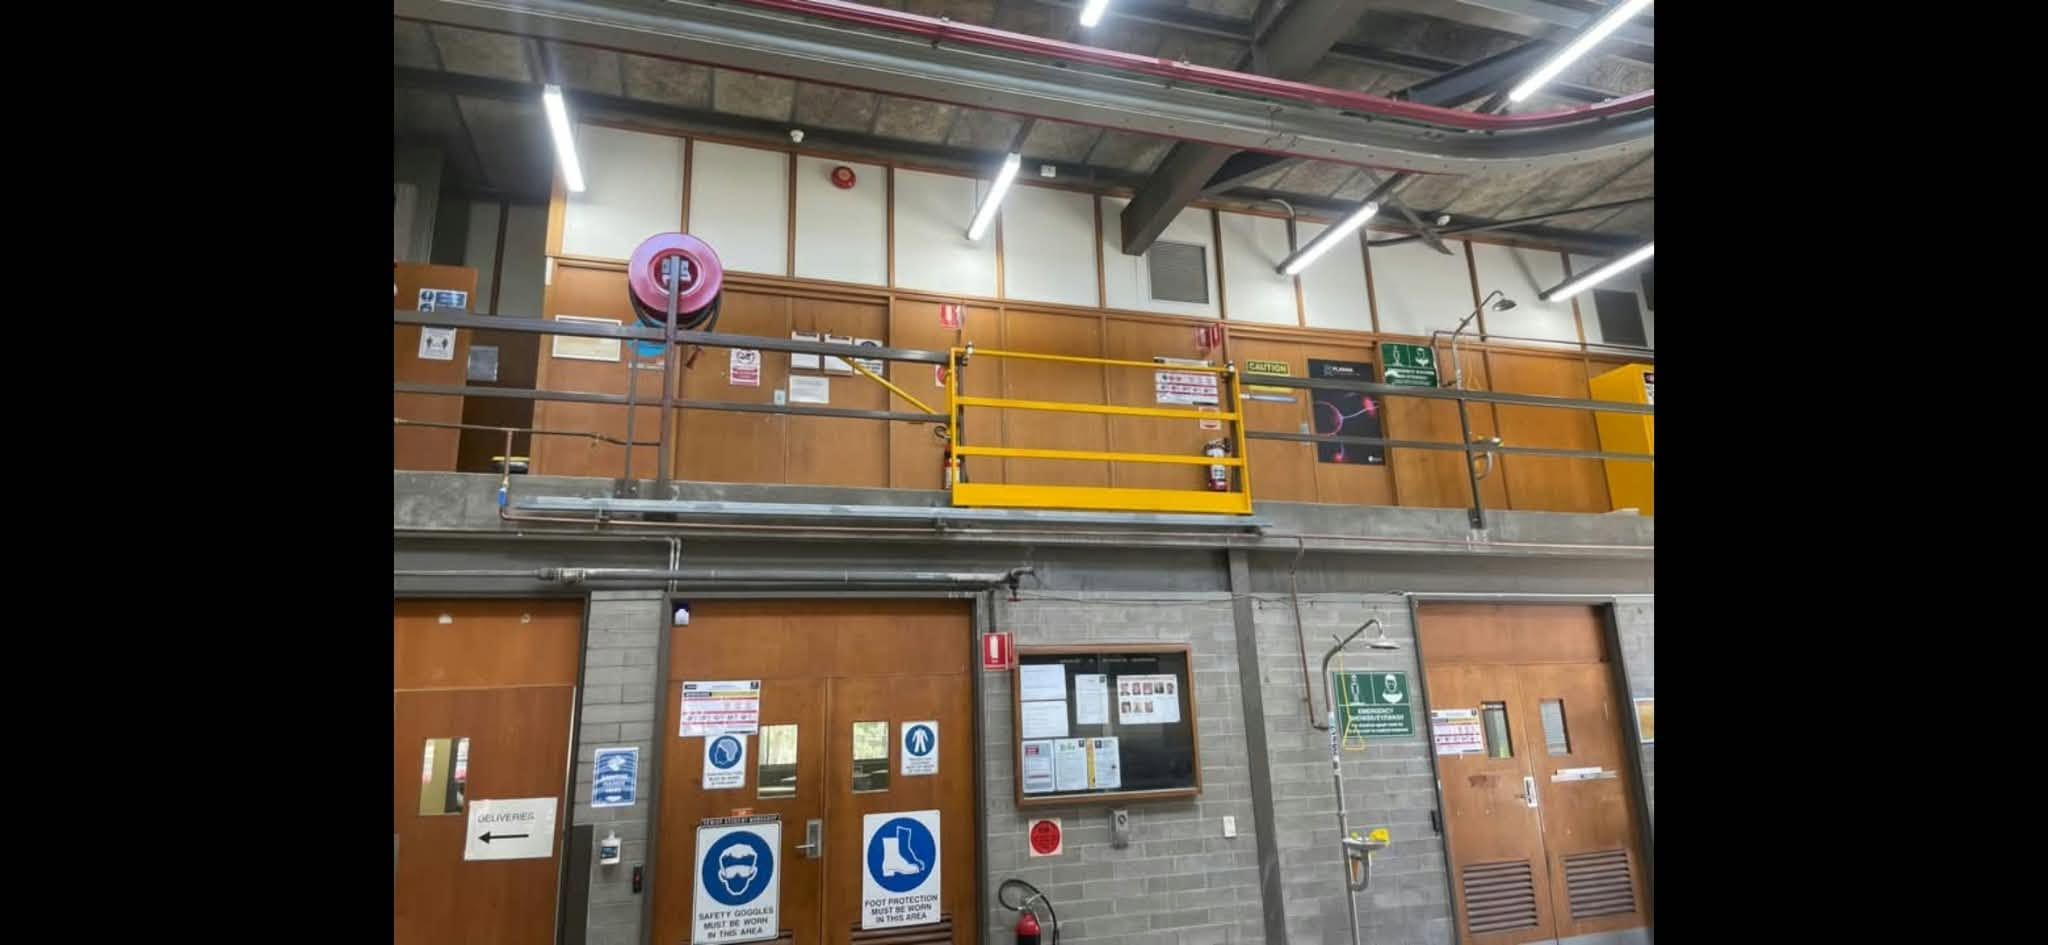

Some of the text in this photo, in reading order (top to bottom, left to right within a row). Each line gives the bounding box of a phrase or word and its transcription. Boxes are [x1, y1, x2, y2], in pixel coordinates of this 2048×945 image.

[1248, 362, 1287, 373] CAUTION
[477, 811, 535, 823] DELIVERIES
[865, 895, 938, 907] FOOT PROTECTION
[699, 906, 774, 920] SAFETY GOGGLES
[871, 903, 932, 915] MUST BE WORN
[703, 917, 768, 929] MUST BE WORN
[875, 912, 927, 923] IN THIS AREA
[707, 927, 763, 939] IN THIS AREA
